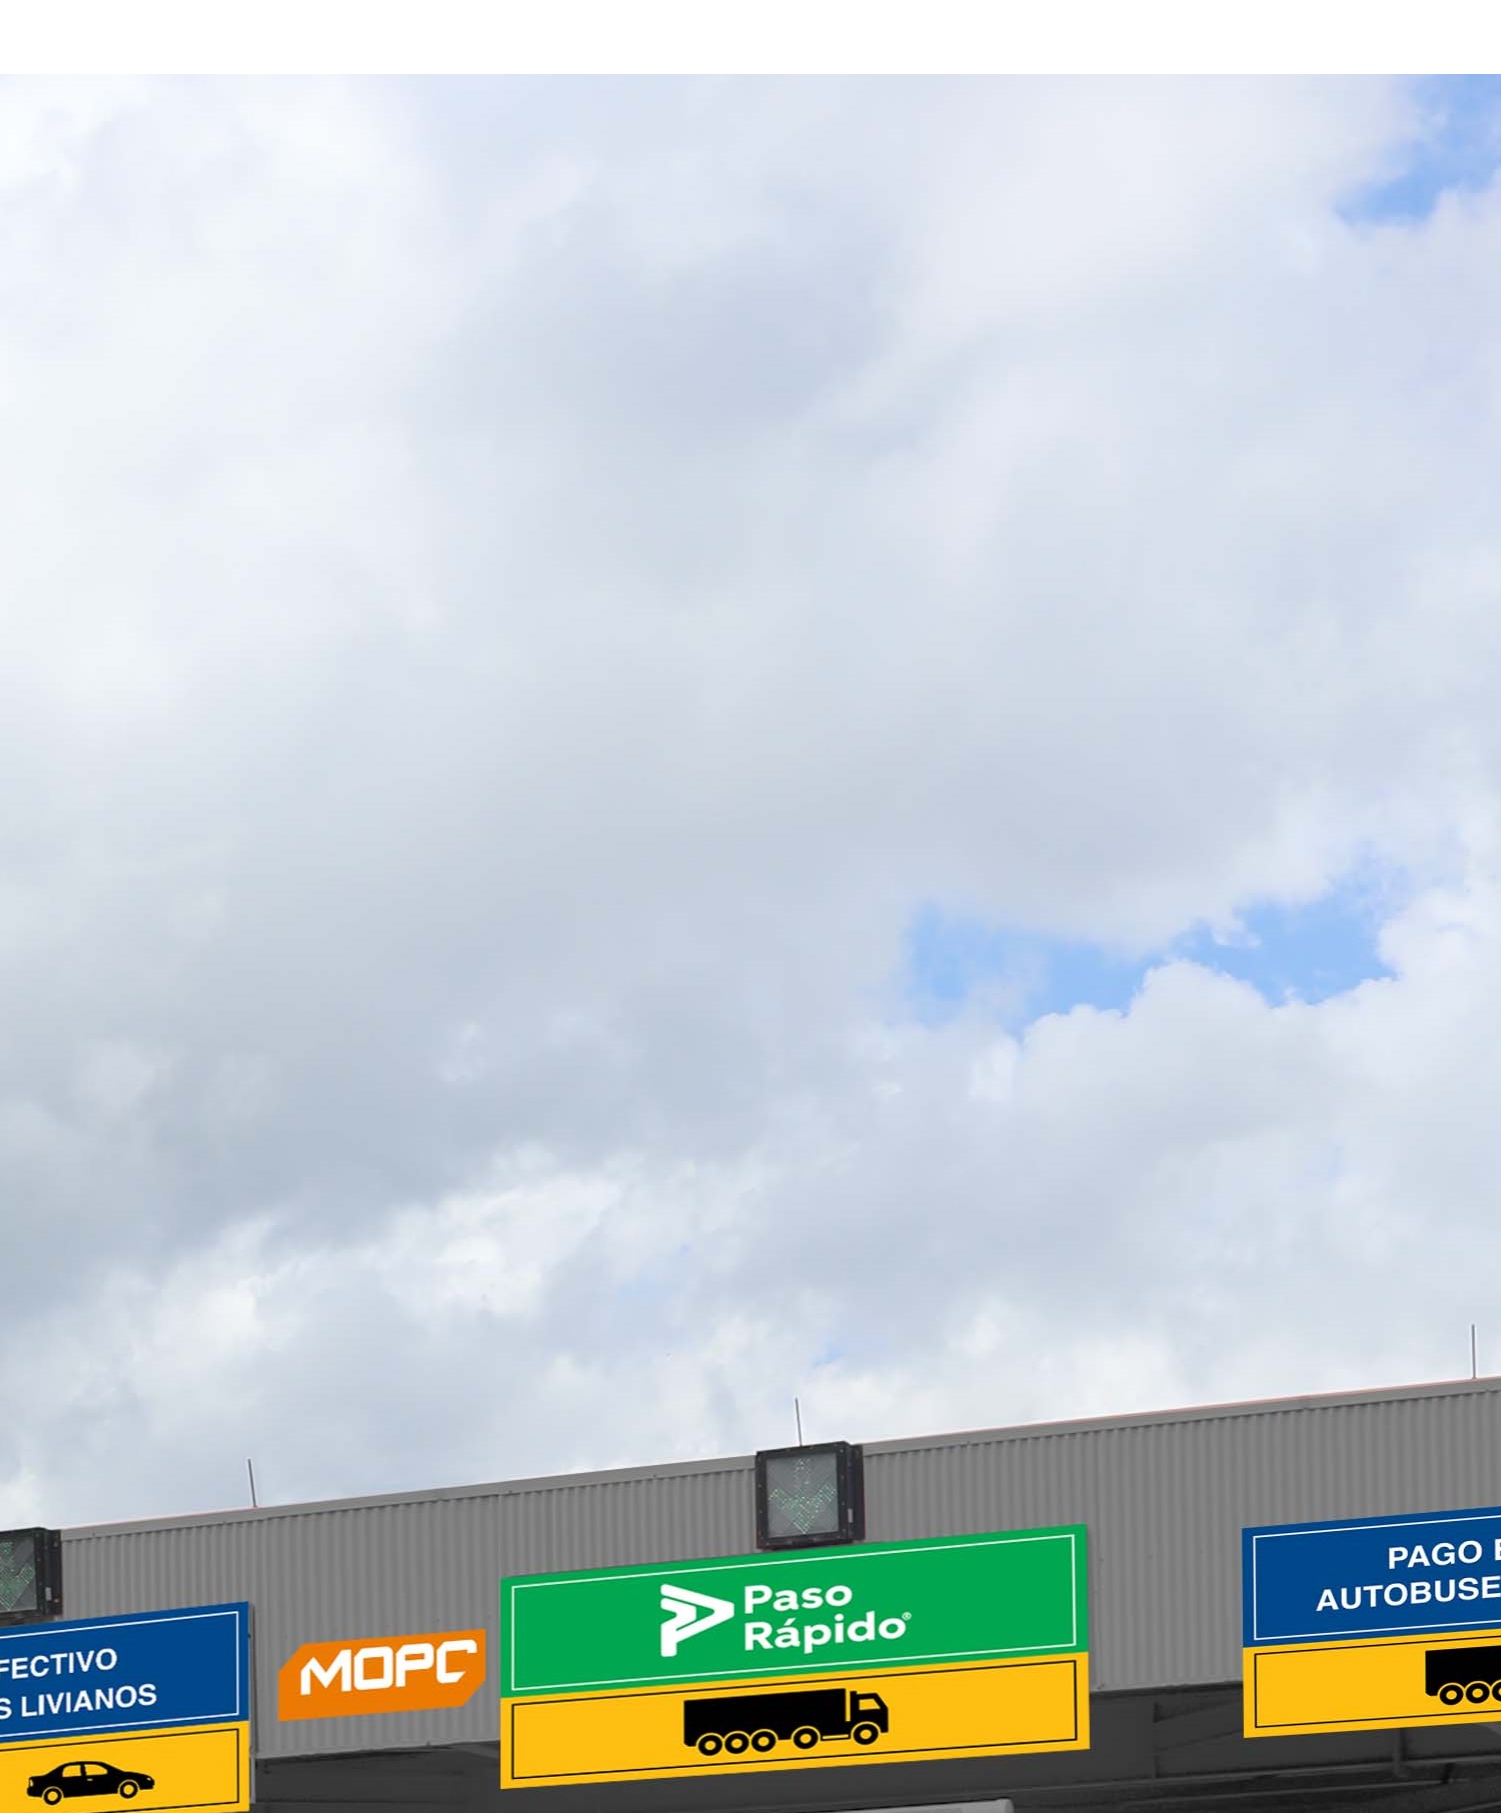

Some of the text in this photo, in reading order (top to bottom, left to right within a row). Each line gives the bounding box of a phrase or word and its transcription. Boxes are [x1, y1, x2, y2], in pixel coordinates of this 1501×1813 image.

[1388, 1541, 1483, 1570] PAGO
[744, 1584, 853, 1614] Paso
[300, 1639, 478, 1696] MOPC
[21, 1683, 157, 1718] LIVIANOS
